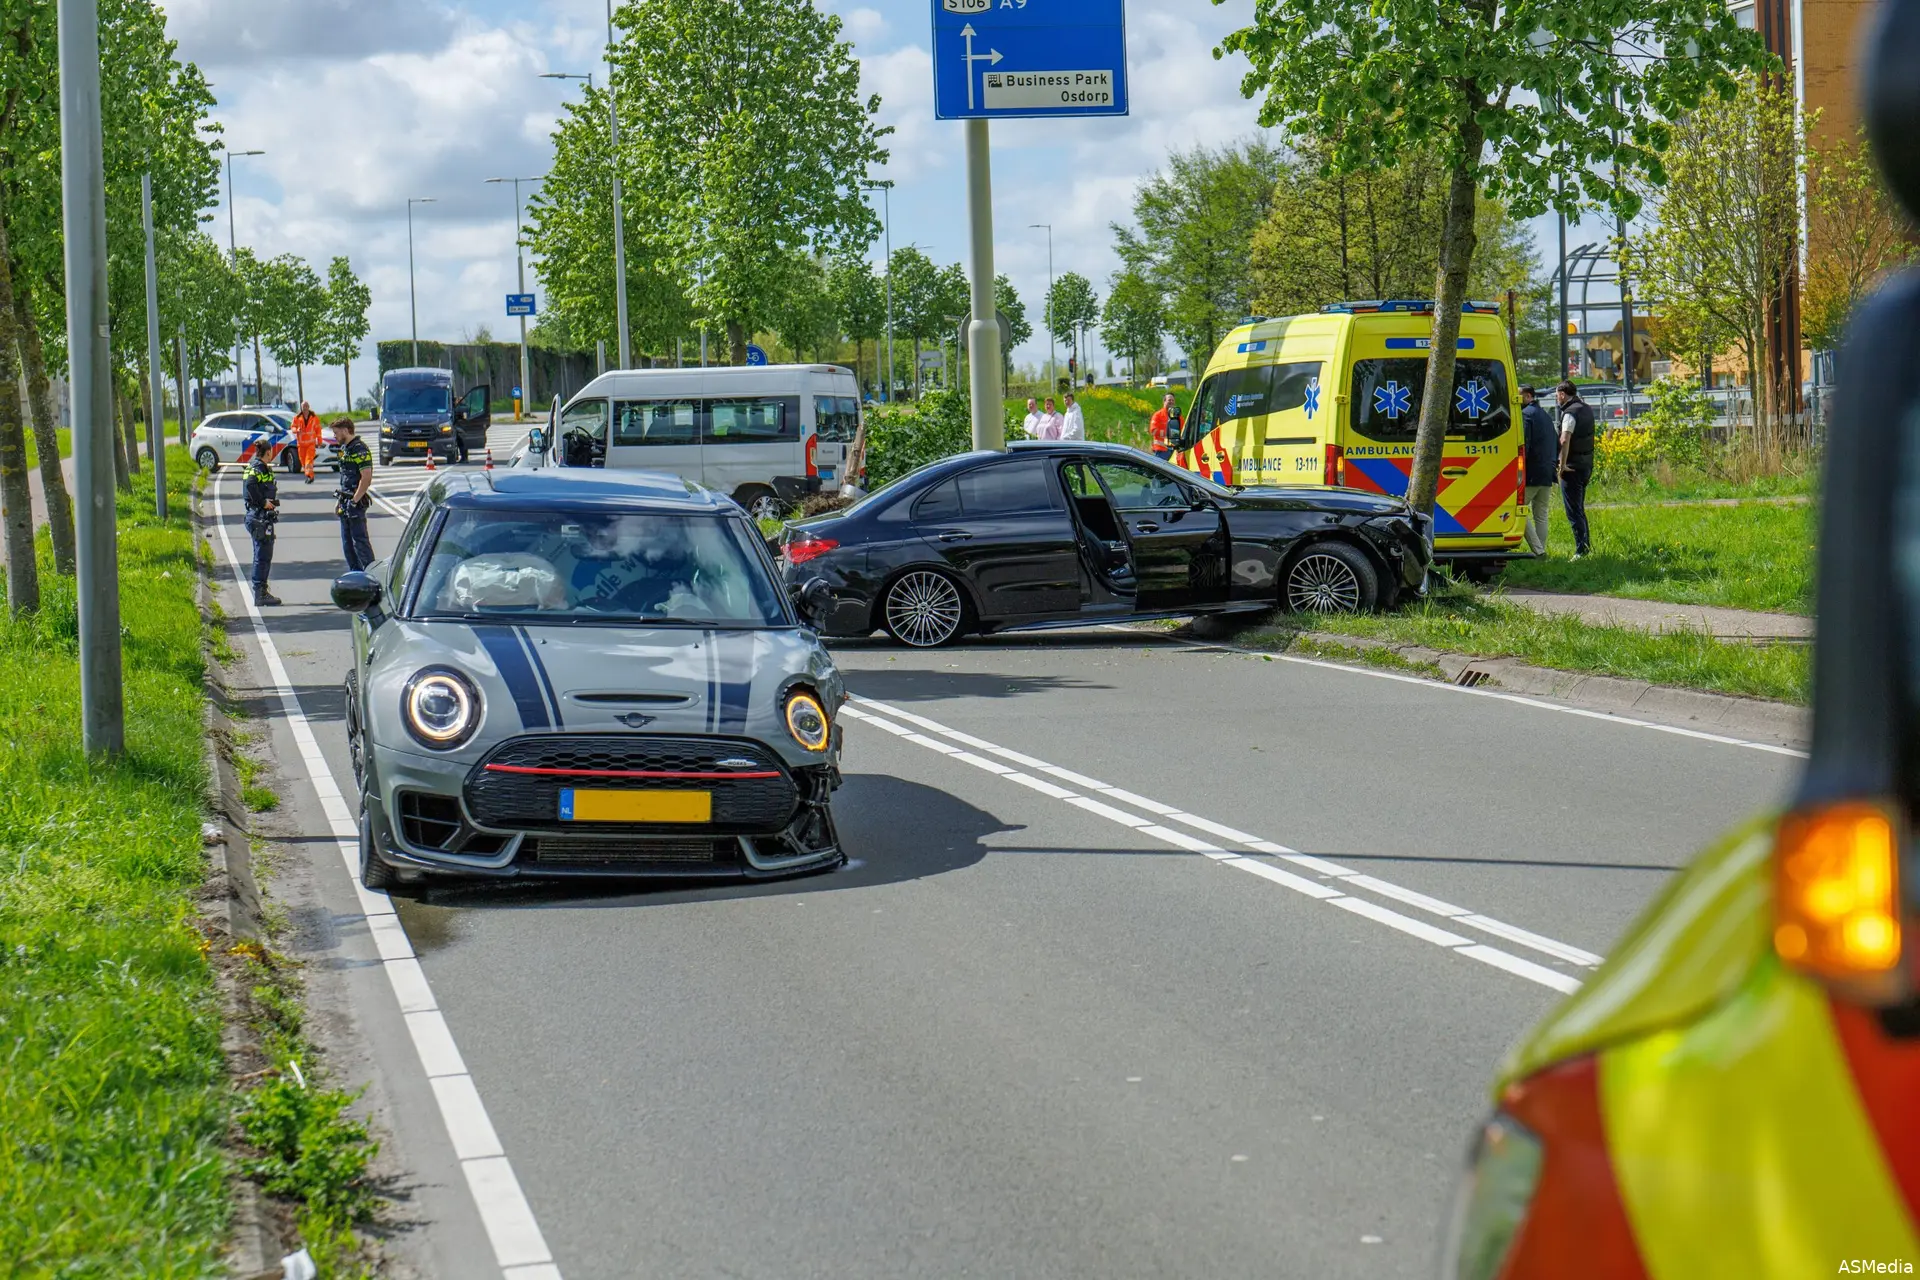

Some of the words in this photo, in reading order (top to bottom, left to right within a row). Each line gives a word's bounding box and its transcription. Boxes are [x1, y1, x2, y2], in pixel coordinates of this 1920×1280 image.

[1007, 74, 1070, 87] Business
[1075, 73, 1107, 85] Park
[1060, 91, 1109, 103] Osdorp
[1346, 446, 1415, 455] AMBULANC
[1465, 445, 1498, 454] 13-111
[1237, 457, 1282, 471] AMBULANCE
[1295, 457, 1318, 471] 13-111
